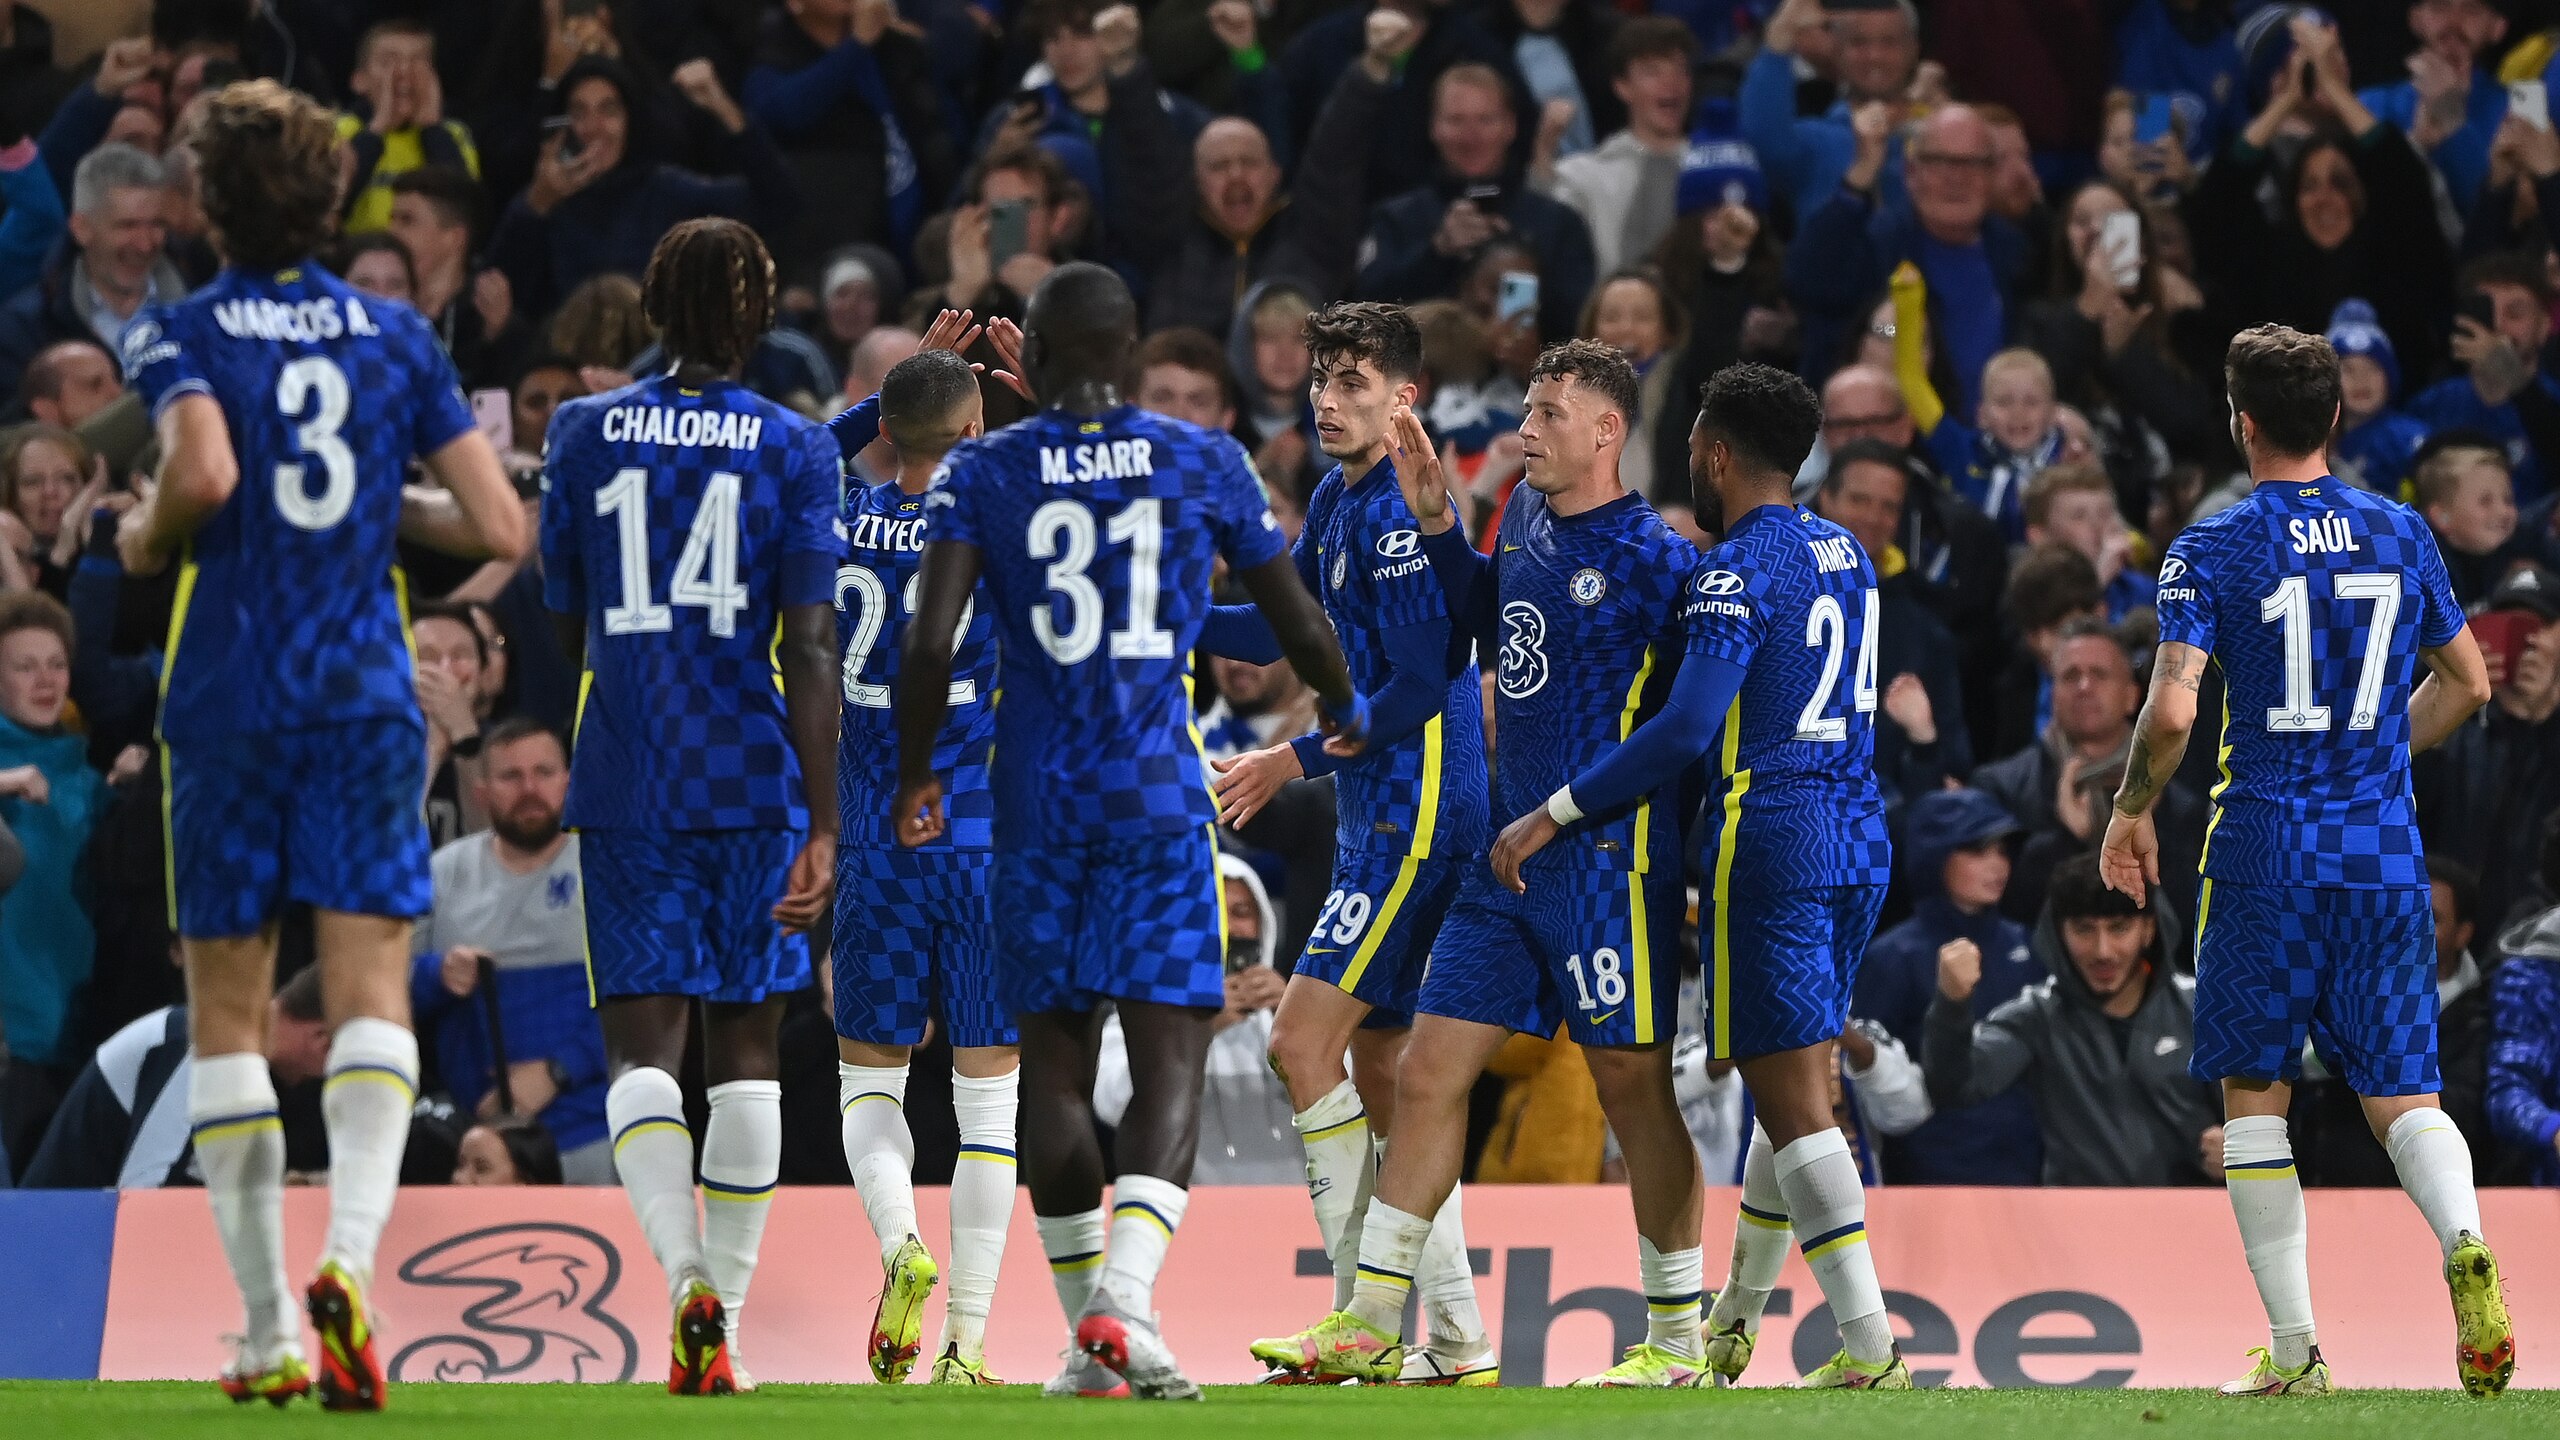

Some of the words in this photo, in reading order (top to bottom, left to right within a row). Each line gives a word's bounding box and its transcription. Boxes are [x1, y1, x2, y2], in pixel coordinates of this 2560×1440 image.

[273, 354, 356, 530] 3
[603, 405, 762, 450] CHALOBAH
[900, 502, 919, 511] CFC
[2298, 487, 2320, 497] CFC
[595, 467, 749, 638] 14
[853, 514, 928, 552] ZIYEC
[2289, 510, 2360, 554] SAÚL
[1372, 553, 1430, 581] HYUNDA
[1808, 537, 1858, 574] JAMES
[1027, 498, 1175, 666] 31
[2157, 588, 2195, 604] NDAI
[1685, 601, 1750, 619] HYUNDAI
[1792, 588, 1880, 741] 24
[2261, 573, 2401, 731] 17
[1311, 889, 1371, 945] 29
[1566, 947, 1626, 1010] 18
[1295, 1247, 2142, 1388] hee
